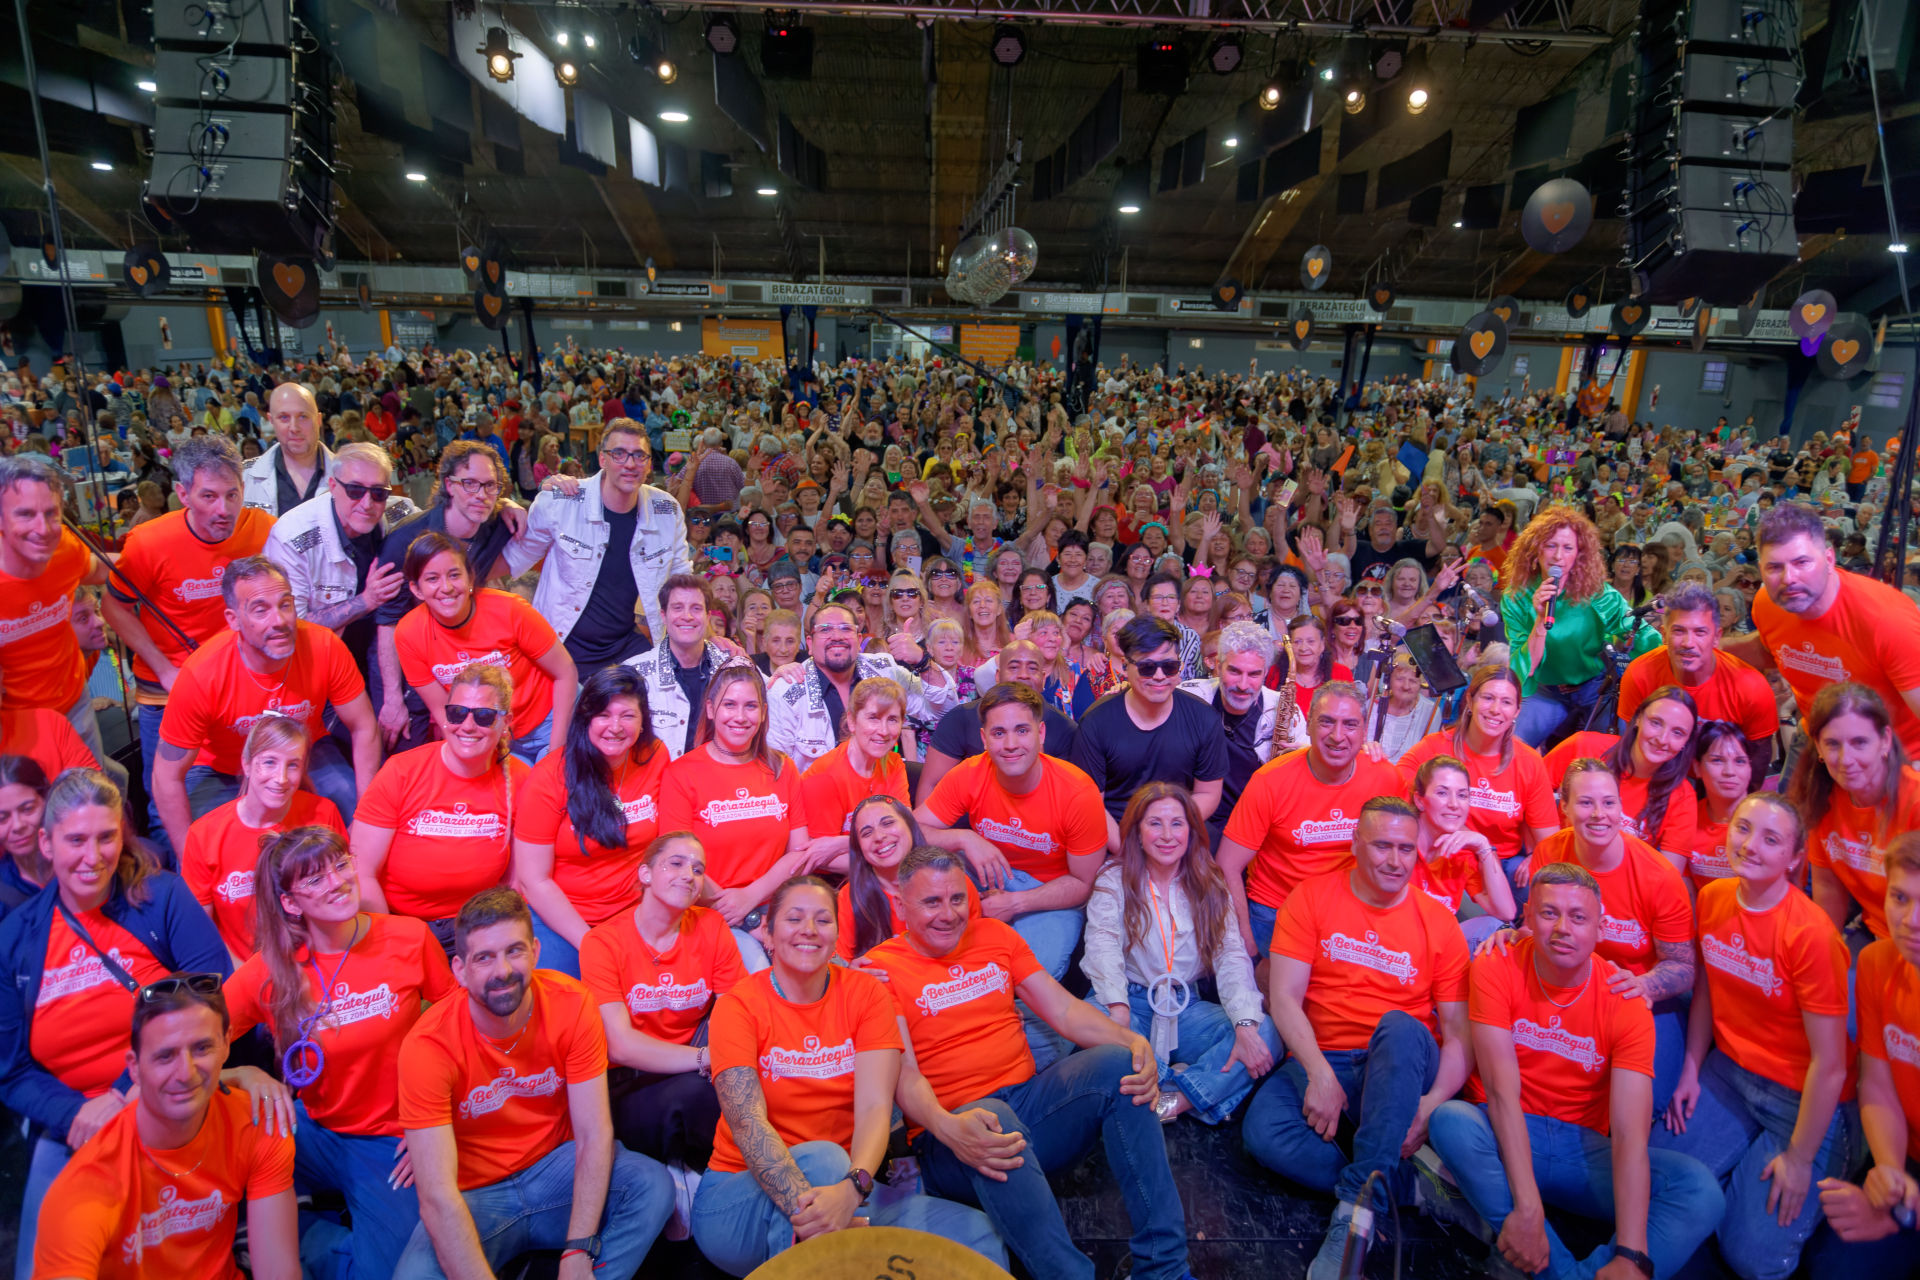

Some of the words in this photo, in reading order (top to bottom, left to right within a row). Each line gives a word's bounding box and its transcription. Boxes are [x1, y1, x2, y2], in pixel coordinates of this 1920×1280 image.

[772, 284, 845, 295] BERAZATEGUI
[772, 295, 845, 304] MUNICIPALIDAD
[1299, 301, 1366, 312] BERAZATEGUI
[711, 796, 777, 813] Berazategui
[421, 812, 497, 829] Berazategui
[983, 821, 1048, 844] Berazategui
[1334, 937, 1407, 965] Berazategui
[1704, 938, 1769, 974] Berazategui
[926, 965, 998, 999] Berazategui
[972, 984, 991, 997] ZONA
[350, 1009, 371, 1021] ZONA
[371, 1002, 388, 1013] SUR
[1517, 1022, 1592, 1051] Berazategui
[774, 1043, 855, 1066] Berazategui
[821, 1065, 844, 1077] ZONA
